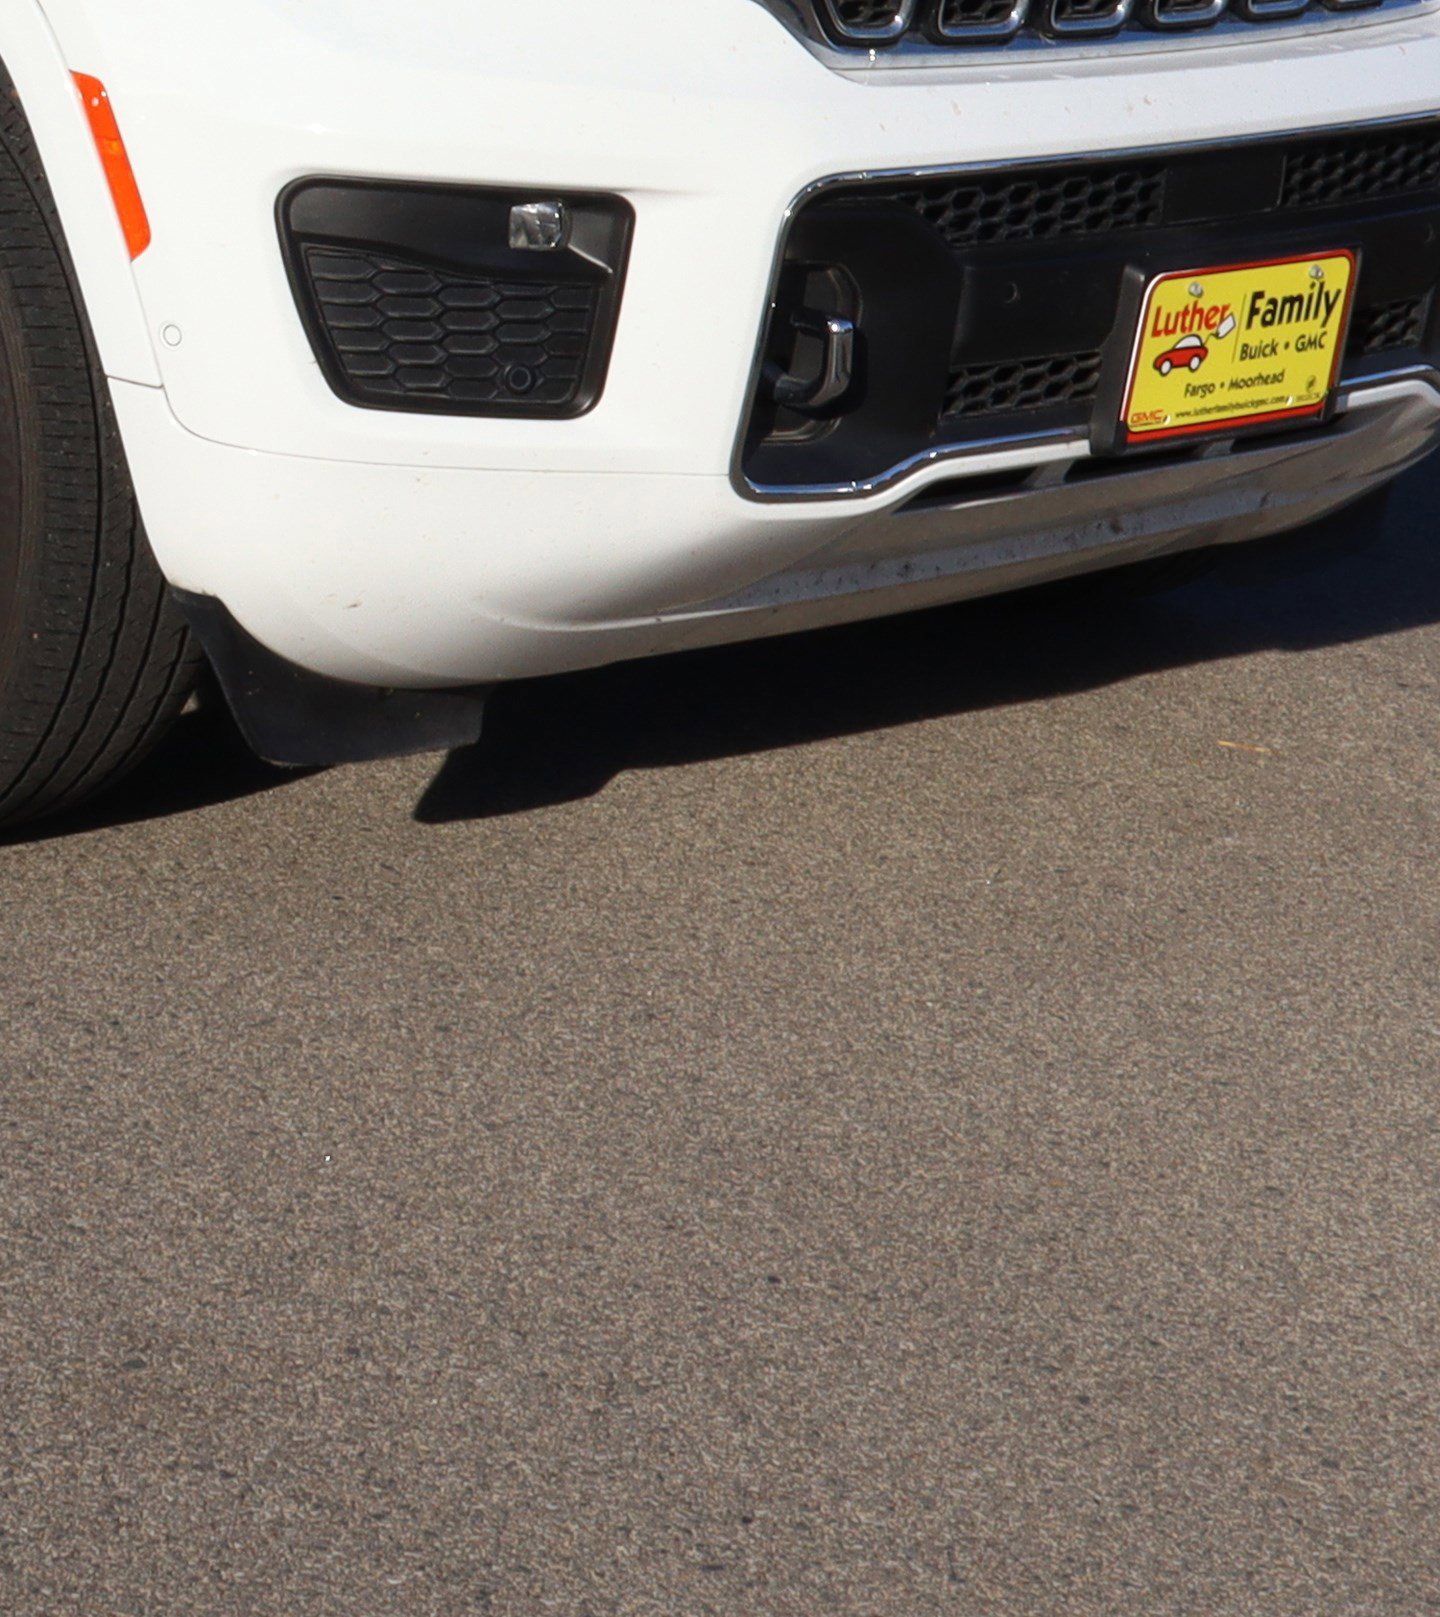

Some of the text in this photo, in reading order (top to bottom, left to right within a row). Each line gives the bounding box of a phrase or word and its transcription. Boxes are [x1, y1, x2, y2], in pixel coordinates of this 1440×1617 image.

[1151, 299, 1232, 338] Luther
[1245, 281, 1342, 331] Family
[1239, 331, 1327, 361] Buick GMC
[1184, 368, 1286, 398] Fargo Moorhead
[1131, 408, 1165, 424] GMC
